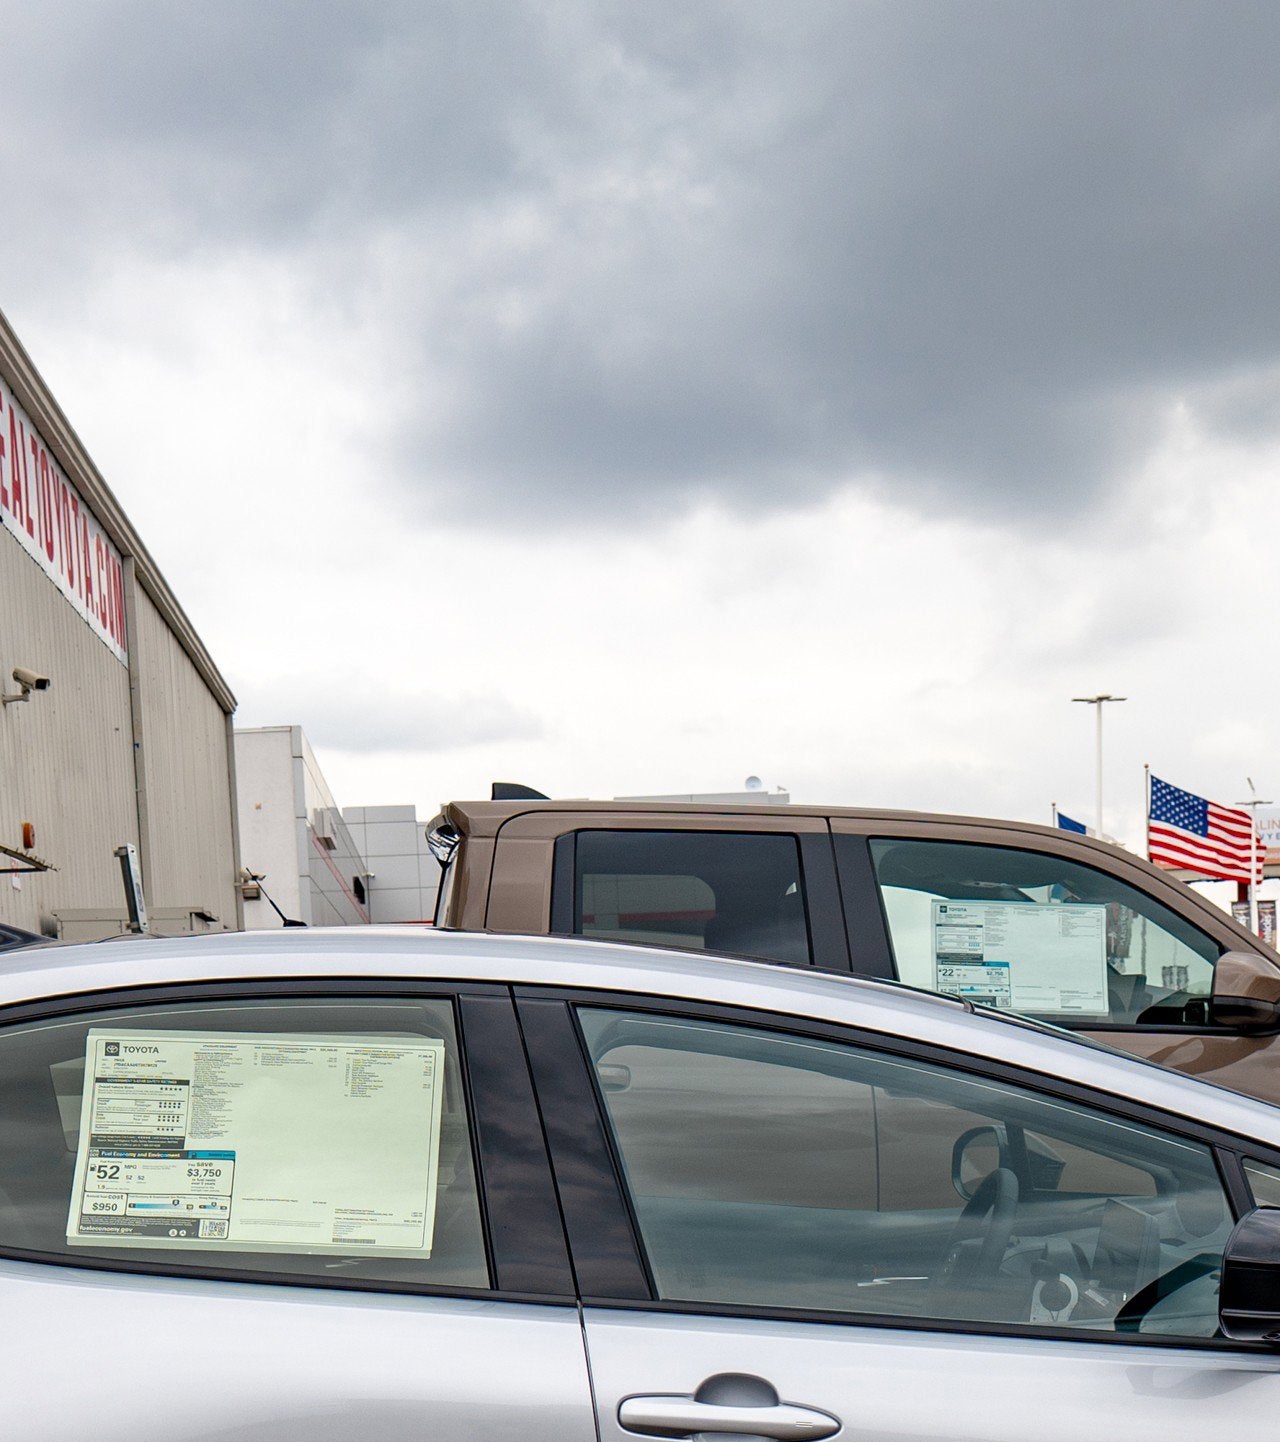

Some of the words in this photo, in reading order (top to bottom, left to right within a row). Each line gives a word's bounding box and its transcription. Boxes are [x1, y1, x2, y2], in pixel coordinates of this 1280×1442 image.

[942, 968, 954, 976] 22
[123, 1046, 159, 1054] TOYOTA
[97, 1165, 120, 1180] 52
[187, 1169, 222, 1178] $3,750
[92, 1202, 118, 1211] $950
